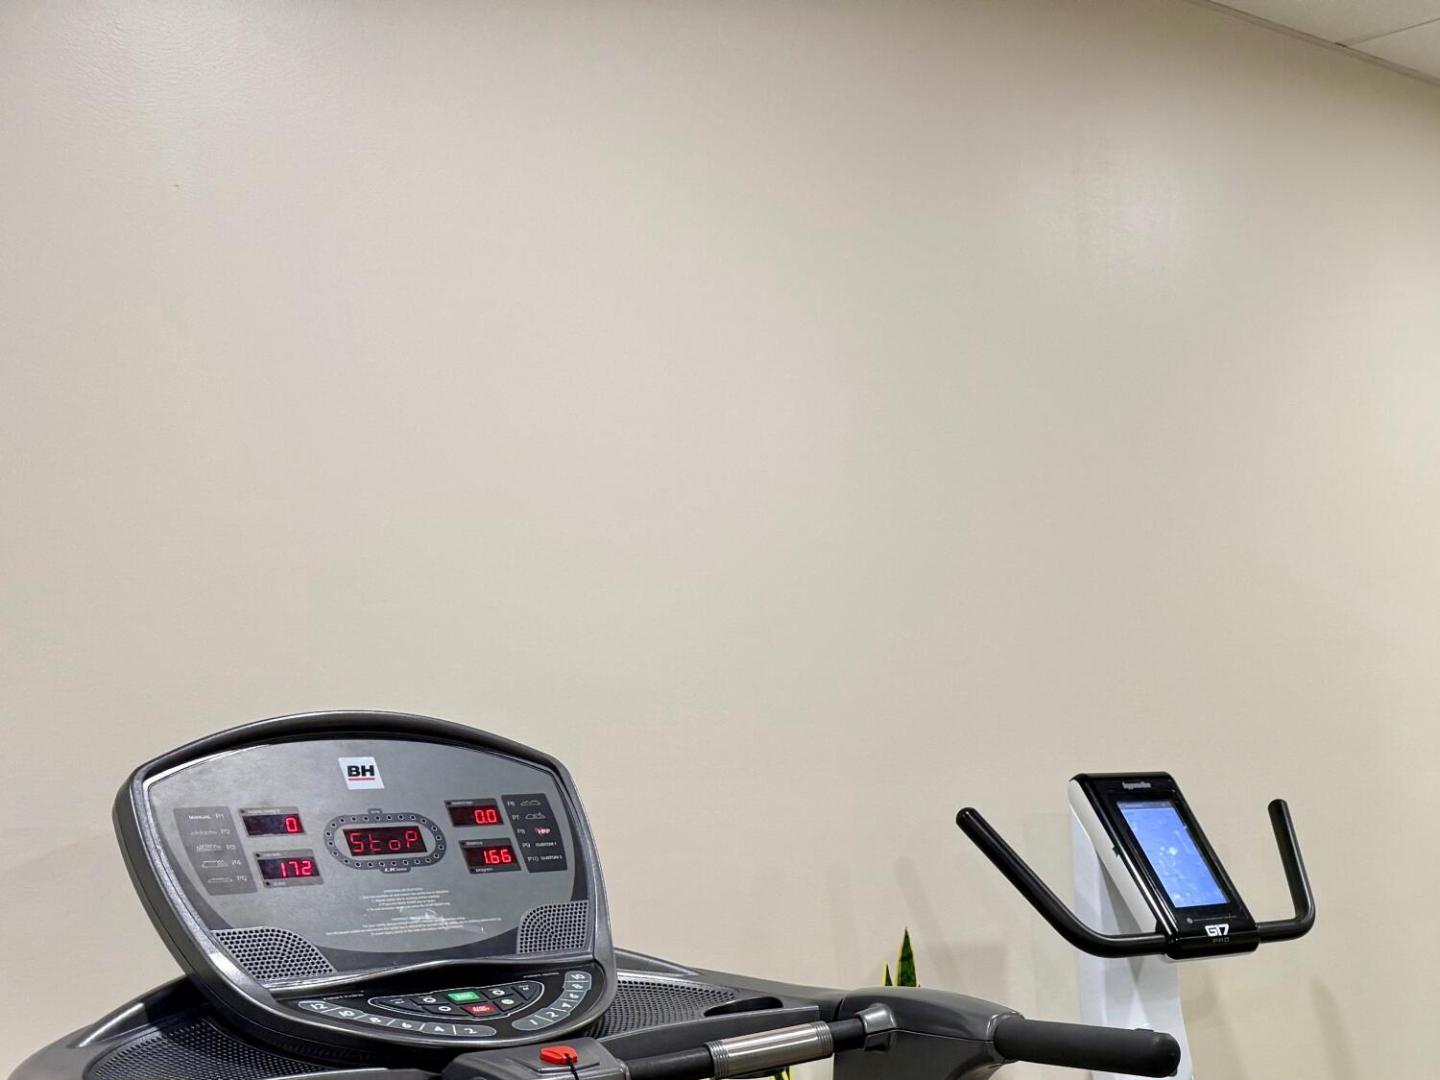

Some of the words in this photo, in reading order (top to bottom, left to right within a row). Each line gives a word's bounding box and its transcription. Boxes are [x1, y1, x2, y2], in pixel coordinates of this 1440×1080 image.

[347, 765, 375, 777] BH
[285, 817, 298, 833] 0
[280, 860, 313, 879] 172
[1204, 923, 1230, 937] G17
